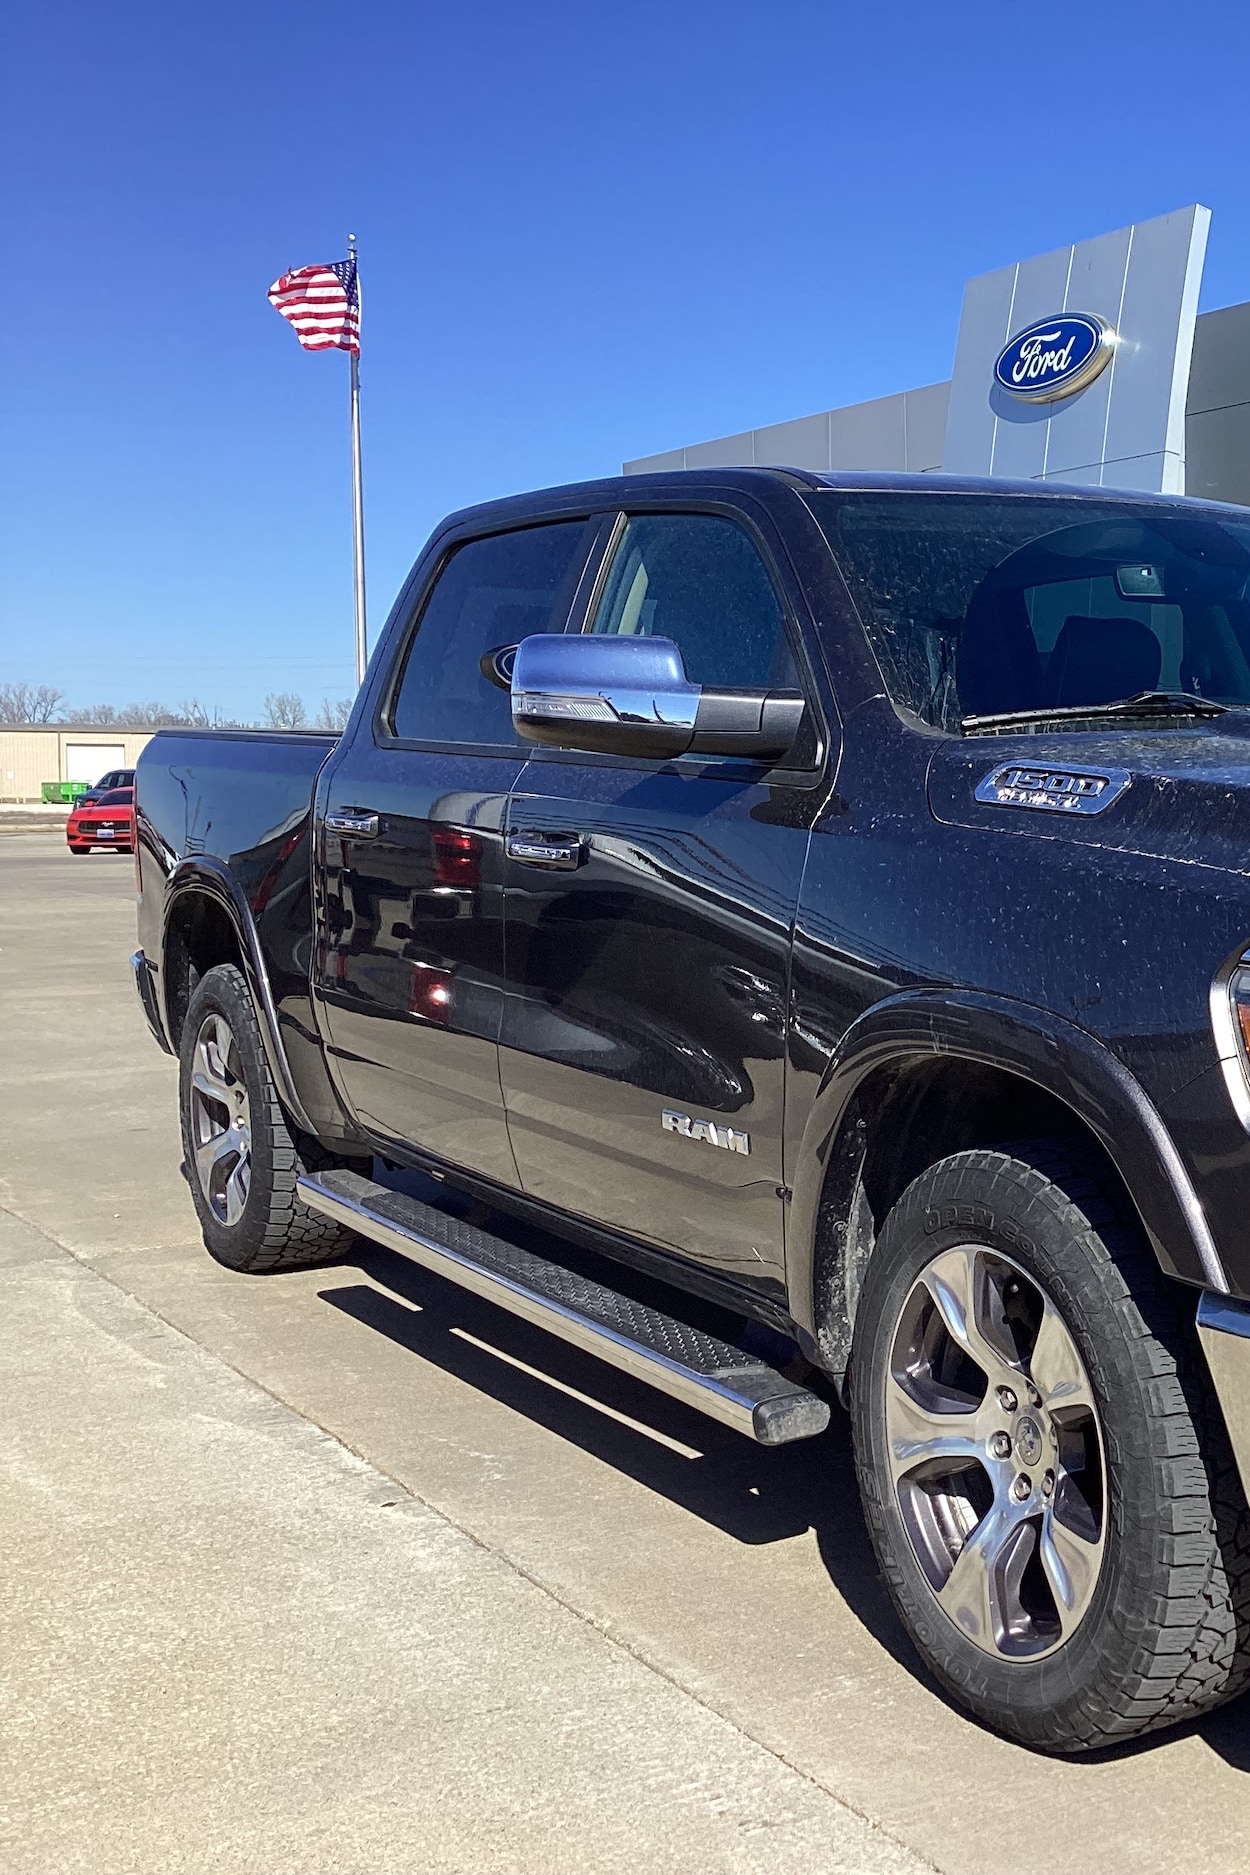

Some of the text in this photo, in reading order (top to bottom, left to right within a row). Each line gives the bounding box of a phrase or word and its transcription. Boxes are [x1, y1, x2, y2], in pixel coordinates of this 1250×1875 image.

[1012, 331, 1076, 383] Ford
[1004, 769, 1106, 797] 1500
[661, 1108, 750, 1156] RAM
